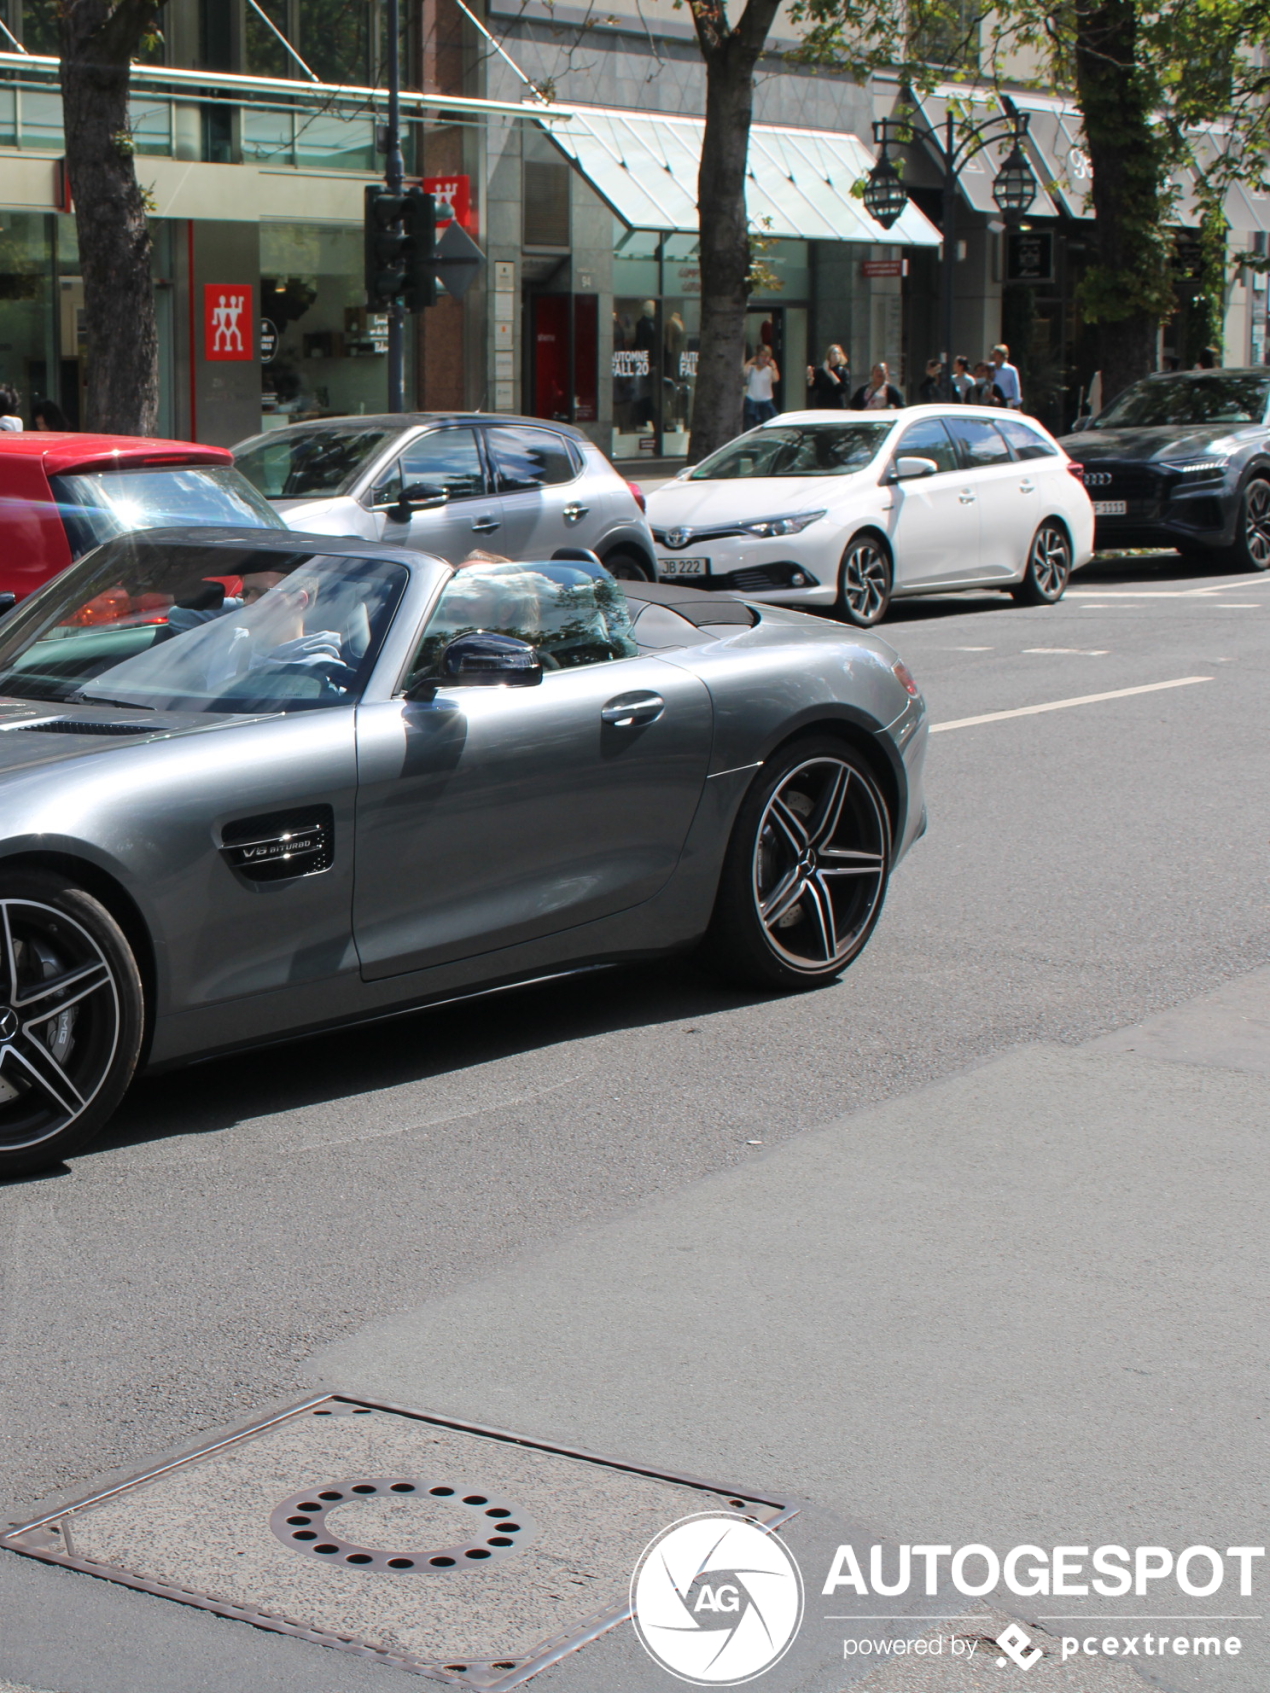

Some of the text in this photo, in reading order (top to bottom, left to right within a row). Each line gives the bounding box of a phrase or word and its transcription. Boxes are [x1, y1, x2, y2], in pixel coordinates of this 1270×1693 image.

[635, 362, 650, 377] 20
[1102, 502, 1125, 514] 1111
[678, 561, 701, 574] 222
[242, 846, 268, 858] V8
